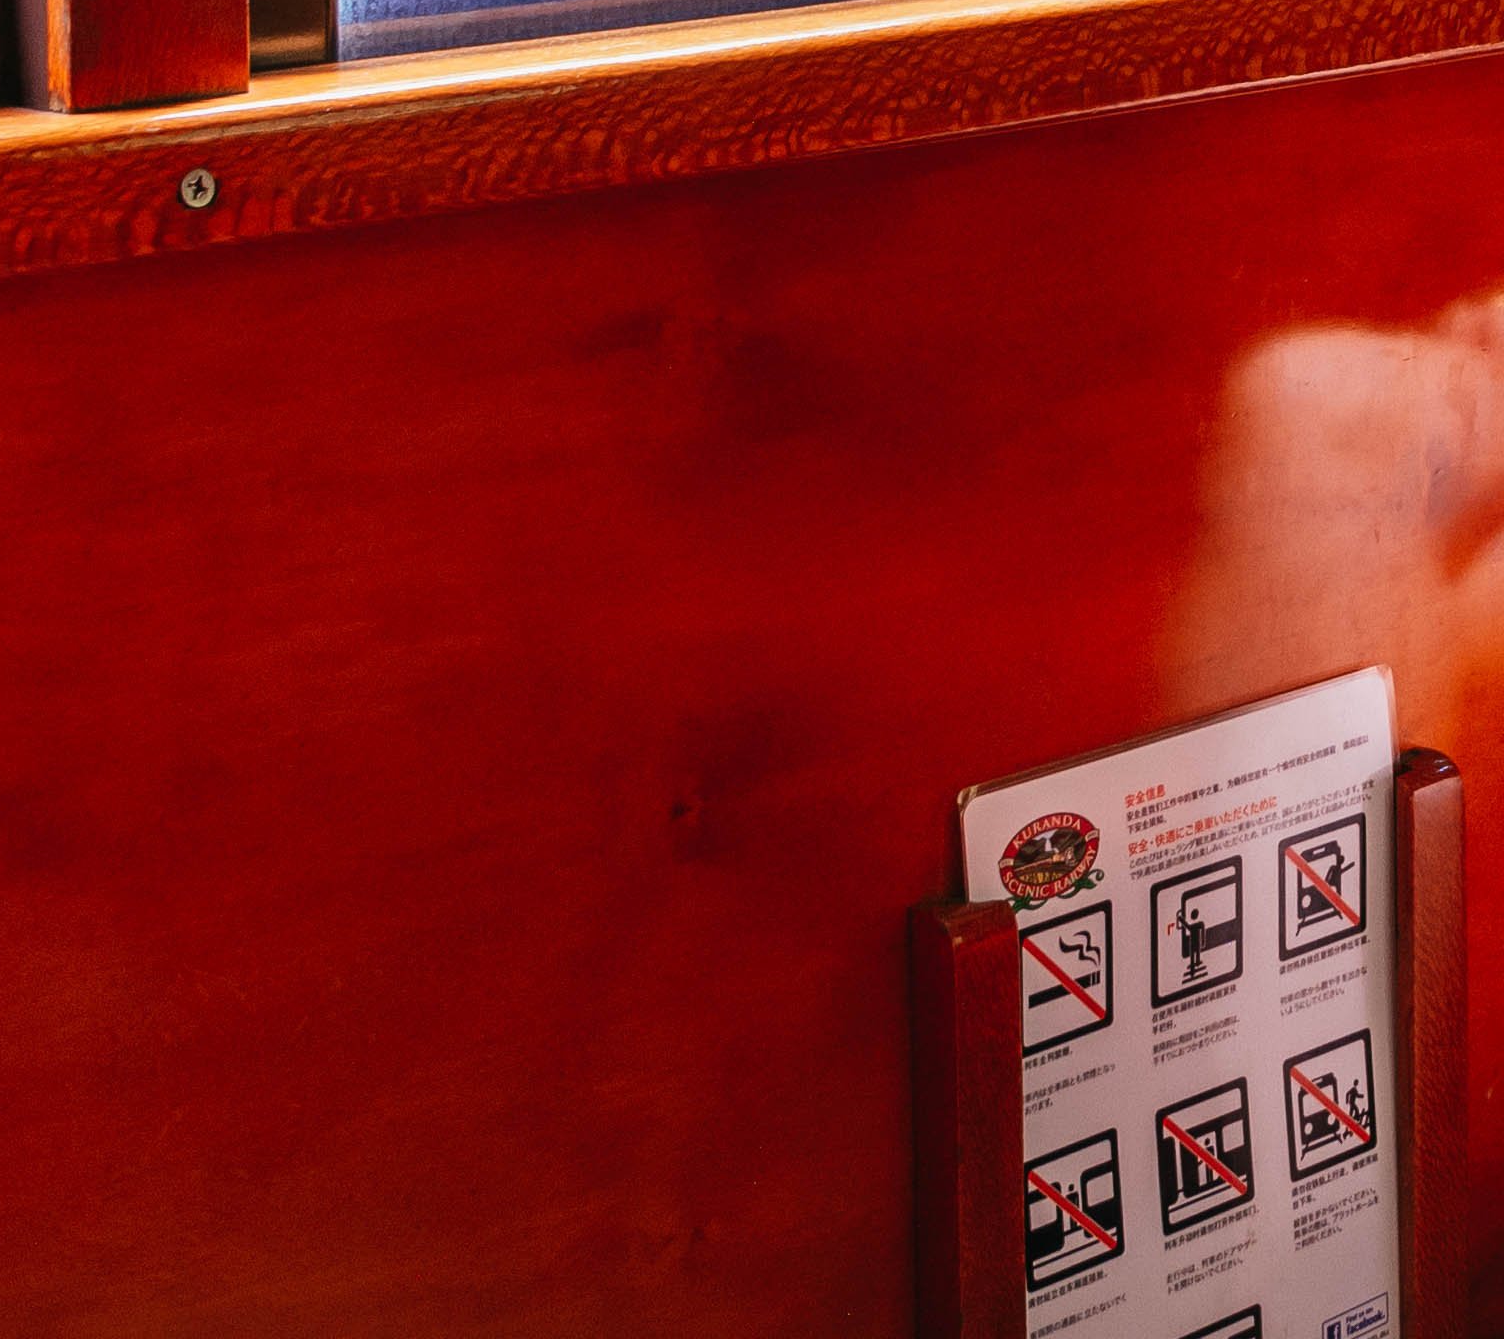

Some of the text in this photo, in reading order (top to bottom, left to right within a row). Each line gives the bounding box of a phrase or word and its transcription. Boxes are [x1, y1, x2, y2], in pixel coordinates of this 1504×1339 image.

[1124, 783, 1166, 809] 安全信息
[1013, 814, 1081, 849] KURANDA
[1003, 846, 1096, 898] SCENIC RAILWAY
